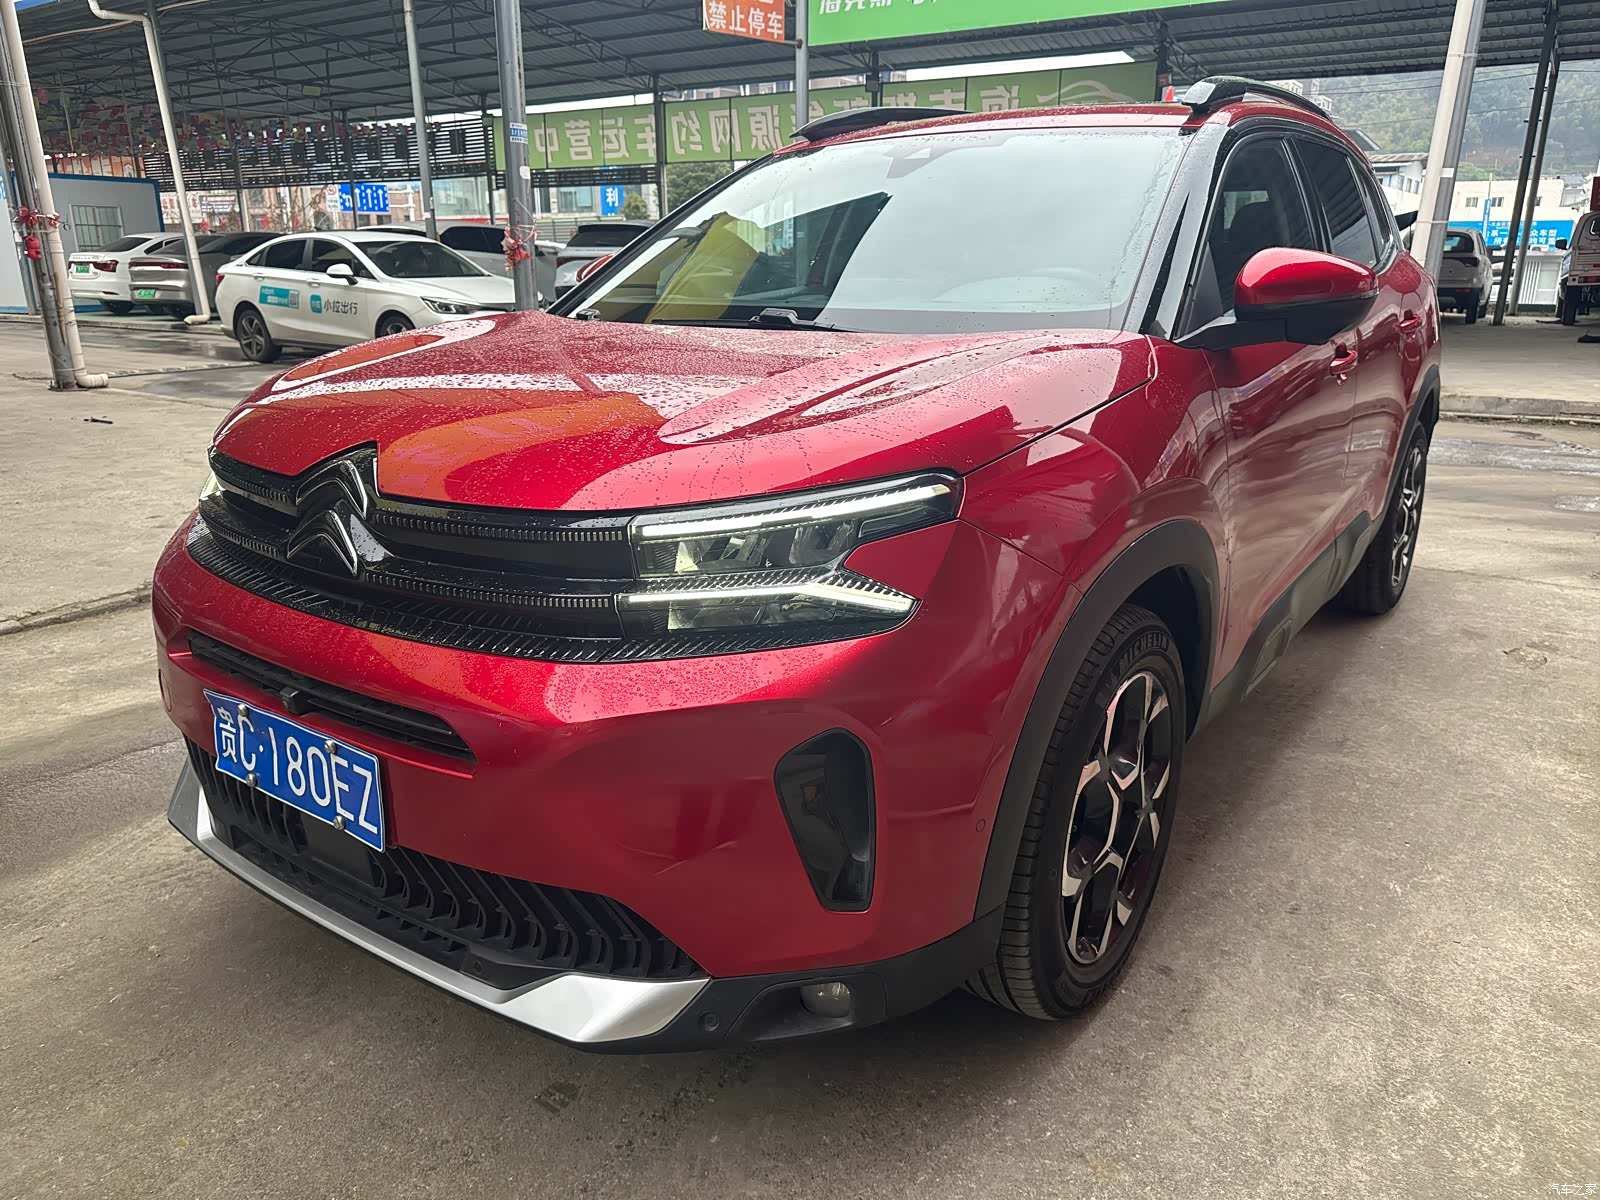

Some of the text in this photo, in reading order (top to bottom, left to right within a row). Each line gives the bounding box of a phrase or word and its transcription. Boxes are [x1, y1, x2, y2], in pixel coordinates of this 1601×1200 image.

[709, 2, 783, 39] 禁止停车
[324, 299, 358, 315] 小拉出行
[1120, 632, 1168, 671] MICHELIN
